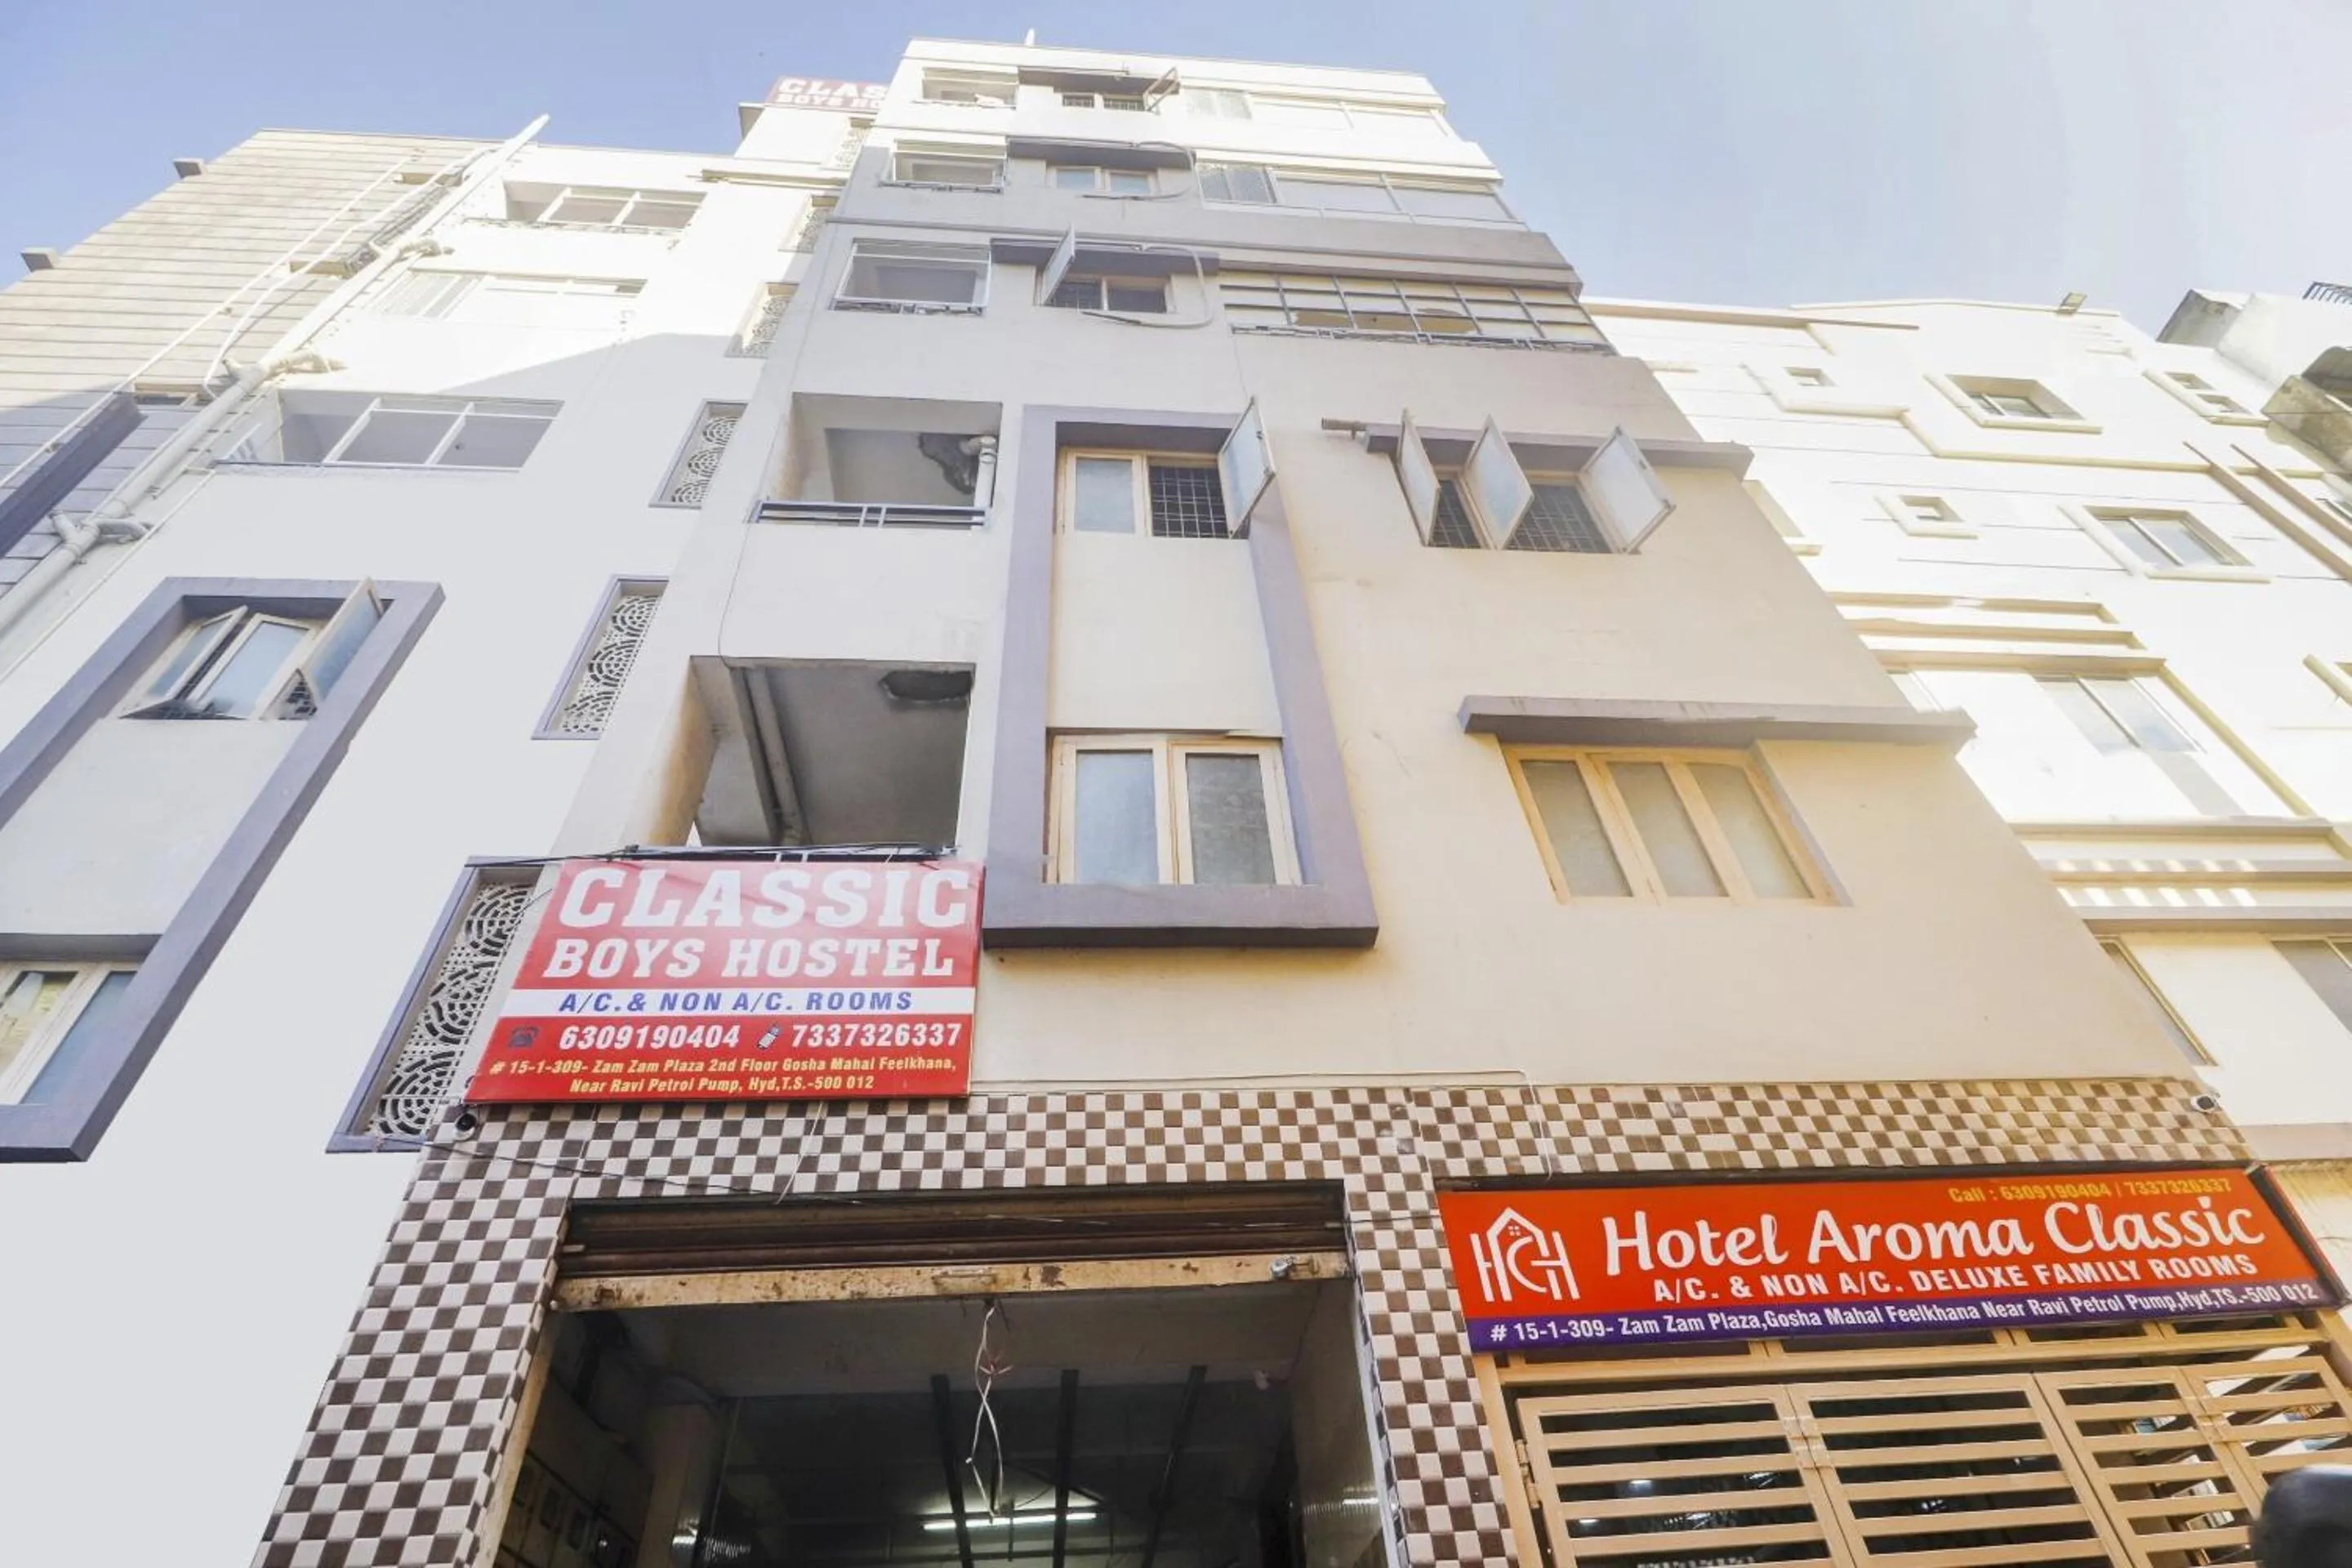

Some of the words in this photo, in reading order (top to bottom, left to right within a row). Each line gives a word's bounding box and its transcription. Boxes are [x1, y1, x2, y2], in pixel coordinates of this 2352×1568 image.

[776, 93, 843, 106] BOYS
[559, 867, 969, 929] CLASSIC
[542, 938, 706, 979] BOYS
[721, 936, 954, 978] HOSTEL
[660, 992, 722, 1012] NON
[732, 991, 793, 1013] A/C.
[805, 991, 912, 1011] ROOMS
[559, 1025, 740, 1050] 6309190404
[791, 1022, 962, 1048] 7337326337
[591, 1060, 624, 1073] Zam
[627, 1059, 659, 1073] Zam
[663, 1059, 705, 1072] Plaza
[708, 1058, 736, 1071] 2nd
[741, 1058, 777, 1071] Floor
[782, 1058, 826, 1071] Gosha
[831, 1057, 874, 1070] Mahal
[879, 1057, 956, 1071] Feelkhana,
[570, 1079, 607, 1093] Near
[610, 1078, 645, 1093] Ravi
[648, 1077, 695, 1092] Petrol
[697, 1077, 742, 1094] Pump,
[846, 1075, 875, 1089] 012
[1948, 1187, 1986, 1202] Call
[1999, 1183, 2112, 1200] 6309190404
[1601, 1209, 1789, 1276] Hotel
[1807, 1209, 2034, 1265] Aroma
[2044, 1196, 2266, 1255] Classic
[1653, 1277, 1719, 1303] A/C.
[1729, 1275, 1754, 1298] &
[1760, 1272, 1830, 1297] NON
[1838, 1270, 1904, 1296] A/C.
[1909, 1264, 2029, 1292] DELUXE
[2032, 1259, 2142, 1285] FAMILY
[2146, 1254, 2259, 1281] ROOMS
[1490, 1324, 1508, 1342] #
[1513, 1319, 1614, 1341] 15-1-309-
[1618, 1316, 1660, 1335] Zam
[1663, 1315, 1705, 1333] Zam
[1824, 1307, 1884, 1326] Mahal
[1885, 1302, 1981, 1323] Feelkhana
[1981, 1300, 2025, 1319] Near
[2027, 1297, 2069, 1316] Ravi
[2070, 1294, 2123, 1314] Petrol
[2281, 1283, 2319, 1301] 012
